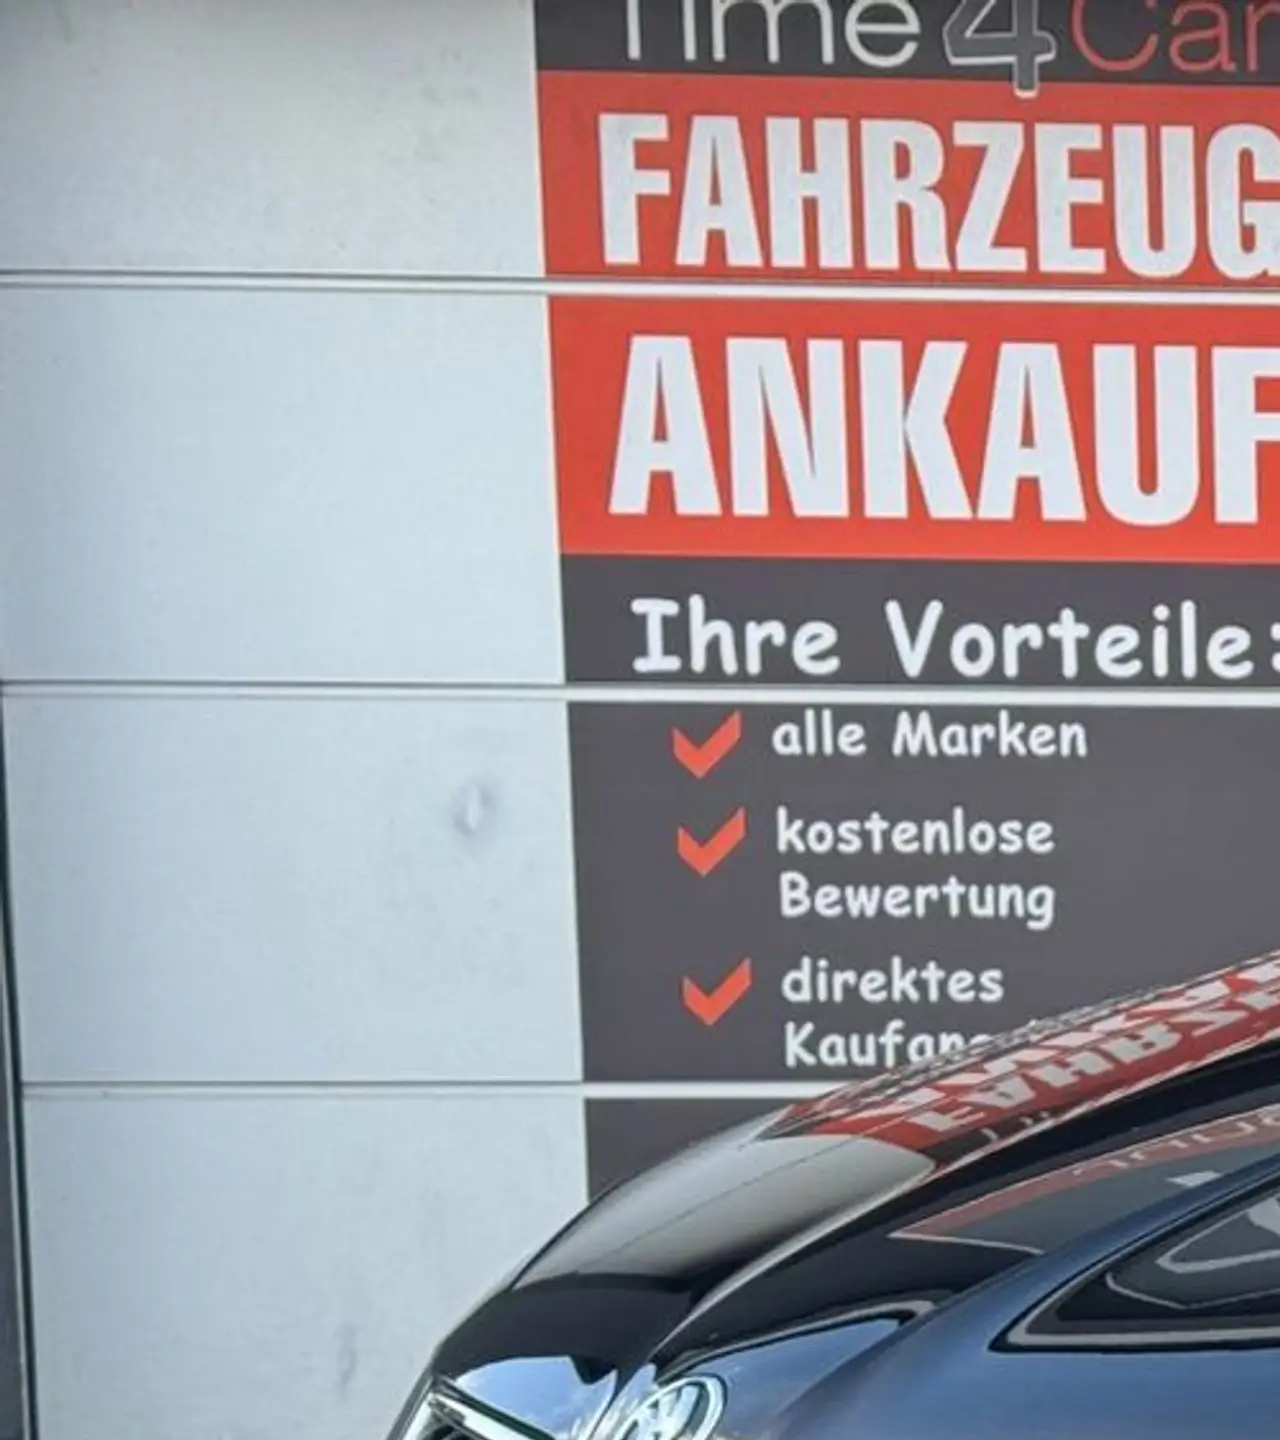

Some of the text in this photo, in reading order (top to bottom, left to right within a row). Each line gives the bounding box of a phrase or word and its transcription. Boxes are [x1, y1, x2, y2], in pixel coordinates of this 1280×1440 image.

[631, 594, 842, 677] Ihre
[771, 709, 1088, 759] alle Marken
[775, 806, 1056, 855] kostenlose
[780, 873, 1057, 930] Bewertung
[781, 957, 1005, 1003] direktes
